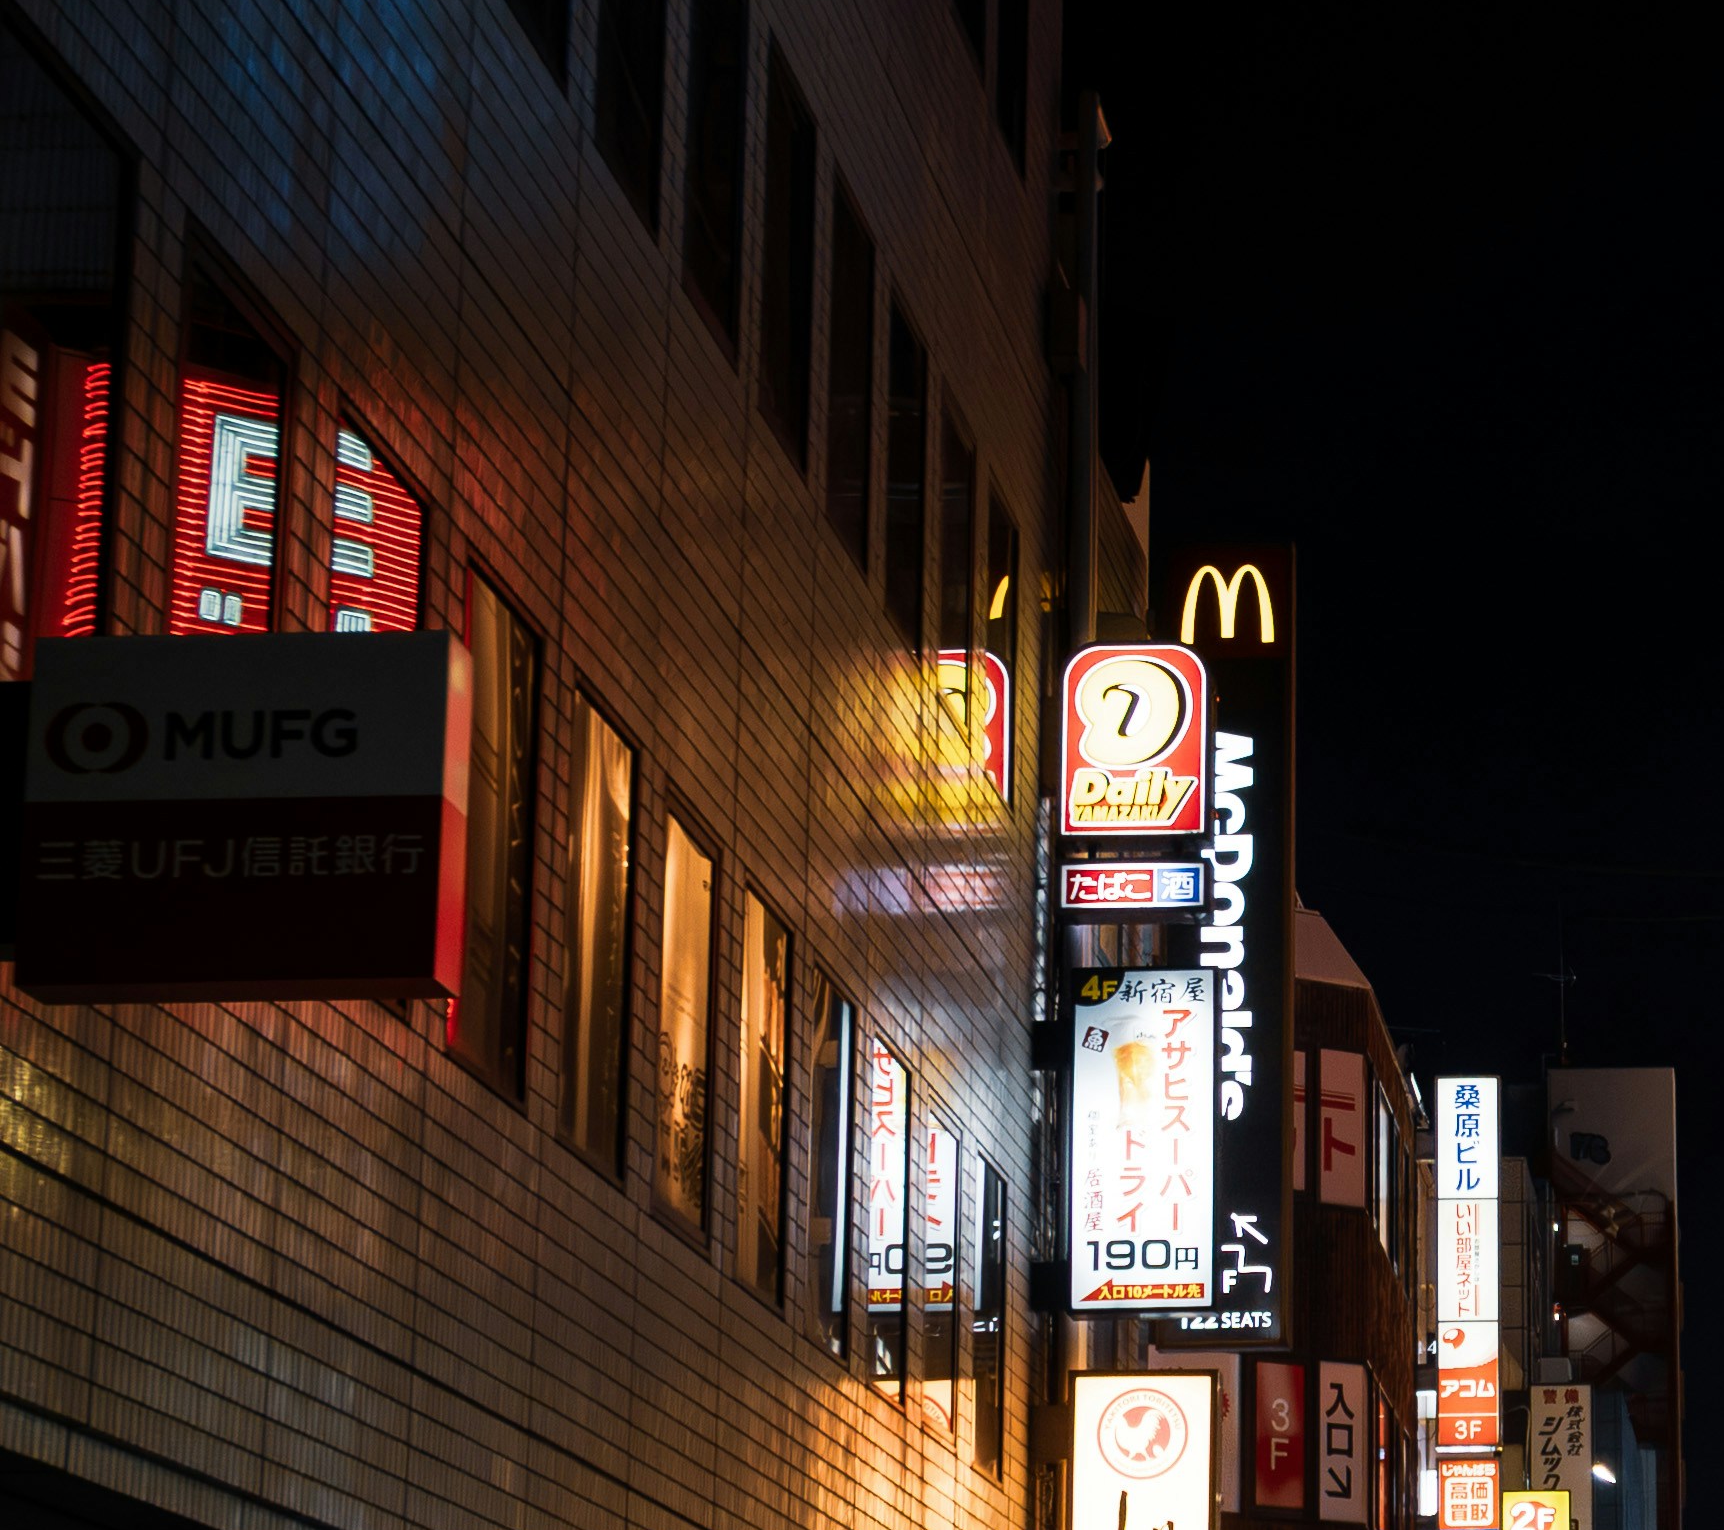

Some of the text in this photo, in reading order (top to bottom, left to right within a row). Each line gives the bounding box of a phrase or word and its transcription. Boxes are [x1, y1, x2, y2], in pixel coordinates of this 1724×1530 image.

[164, 709, 357, 760] MUFG
[1074, 770, 1193, 820] Daily
[1074, 805, 1162, 821] YAMAZAKI
[35, 835, 426, 881] 三菱UFJ信託銀行
[1070, 873, 1151, 901] たばこ
[1161, 871, 1194, 900] 酒
[1081, 975, 1206, 1006] 4F 新宿屋
[1083, 1027, 1108, 1053] 魚
[1161, 1009, 1195, 1232] アサヒスーパー
[1454, 1083, 1481, 1192] 桑原ビル
[1117, 1130, 1146, 1234] ドライ
[1083, 1168, 1104, 1233] 居酒屋
[1086, 1239, 1199, 1272] 190円
[1456, 1203, 1473, 1318] いい部屋ネット
[1099, 1282, 1201, 1300] 入口10メートル先
[1222, 1312, 1273, 1329] SEATS
[1440, 1379, 1496, 1398] アコム
[1271, 1397, 1291, 1471] 3F
[1454, 1419, 1483, 1441] 3F
[1441, 1463, 1496, 1478] じゃんぱら
[1450, 1481, 1489, 1500] 高価
[1450, 1504, 1490, 1522] 買取
